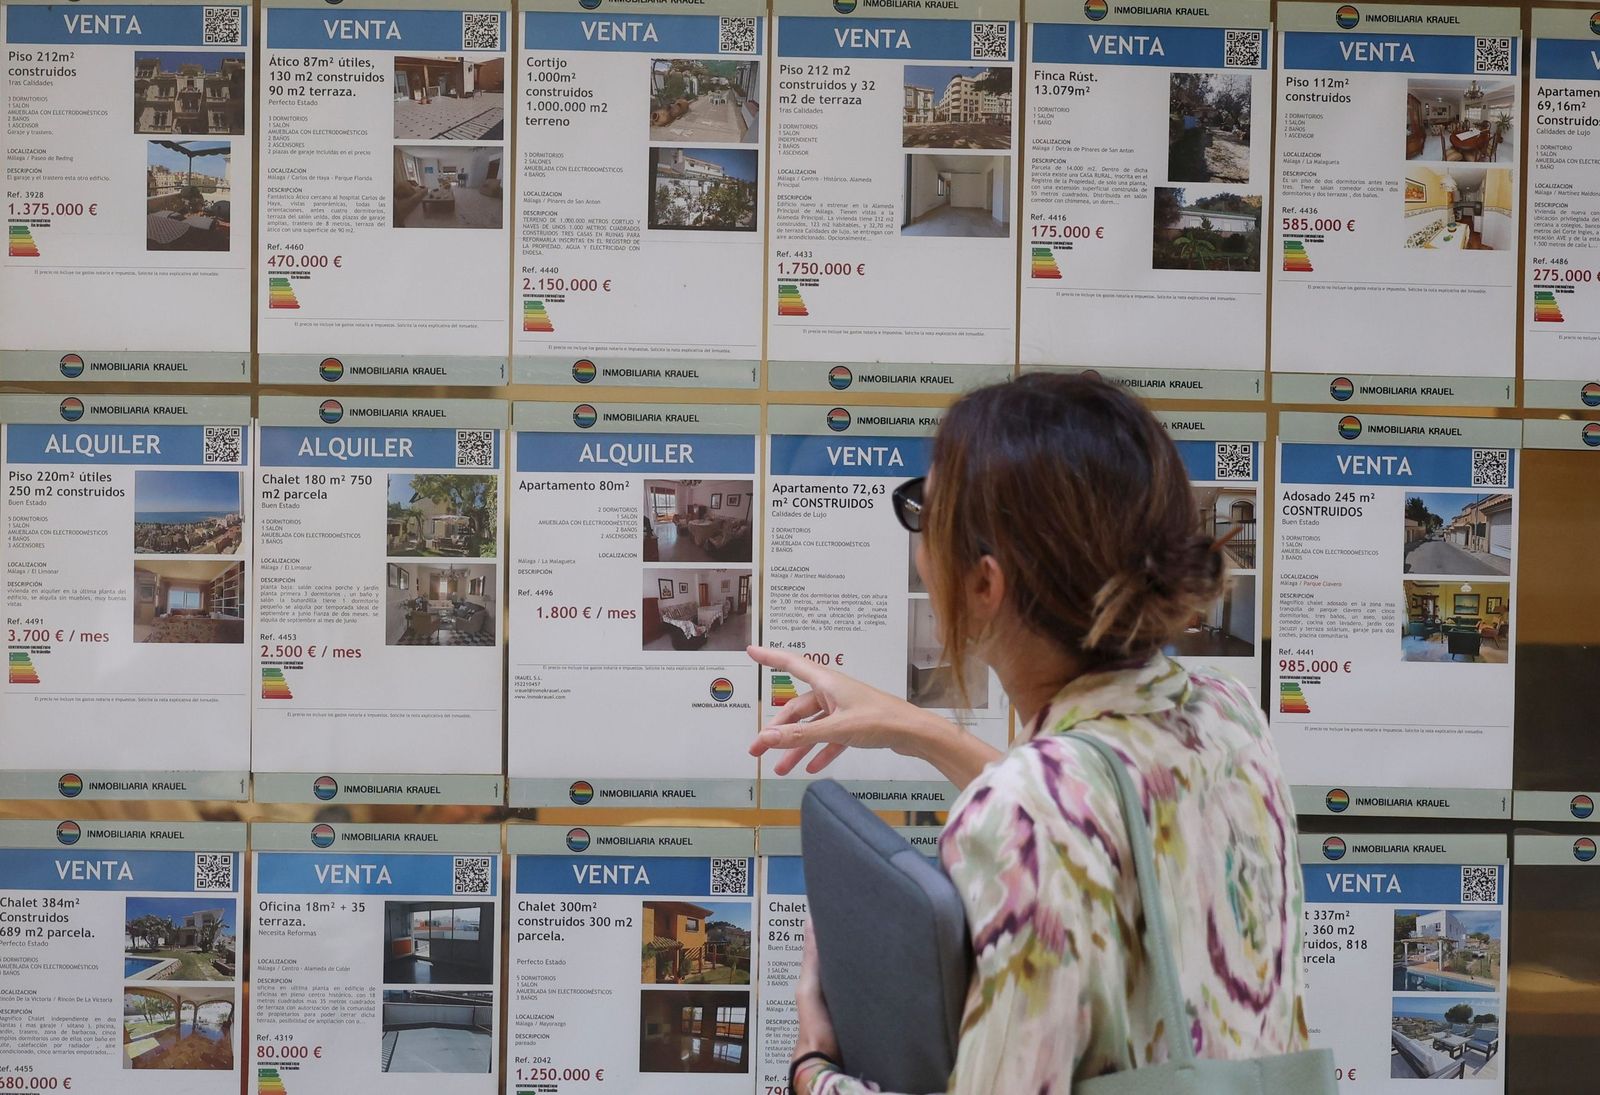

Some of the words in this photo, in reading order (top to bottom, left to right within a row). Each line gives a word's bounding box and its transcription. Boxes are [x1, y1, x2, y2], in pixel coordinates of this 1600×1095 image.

[1114, 6, 1172, 15] INMOBILIARIA
[64, 14, 142, 34] VENTA
[324, 20, 401, 40] VENTA
[581, 21, 658, 42] VENTA
[834, 28, 911, 48] VENTA
[1088, 35, 1164, 56] VENTA
[1340, 41, 1414, 62] VENTA
[9, 51, 32, 61] Piso
[37, 51, 74, 62] 212m²
[269, 54, 299, 66] Ático
[303, 56, 334, 67] 87m²
[338, 57, 375, 69] útiles,
[527, 57, 567, 70] Cortijo
[780, 64, 803, 75] Piso
[808, 65, 828, 75] 212
[833, 66, 850, 75] m2
[8, 66, 76, 76] construidos
[270, 71, 291, 81] 130
[295, 71, 313, 81] m2
[317, 72, 384, 82] construidos
[528, 72, 576, 82] 1.000m²
[1034, 70, 1065, 81] Finca
[1070, 71, 1098, 82] Rúst.
[780, 80, 846, 90] construidos
[850, 83, 857, 93] y
[862, 80, 875, 91] 32
[1286, 77, 1309, 87] Piso
[1314, 78, 1349, 88] 112m²
[269, 85, 283, 95] 90
[287, 86, 305, 96] m2
[309, 87, 356, 96] terraza.
[526, 88, 593, 98] construidos
[1035, 85, 1090, 96] 13.079m²
[780, 94, 797, 104] m2
[801, 94, 815, 104] de
[819, 96, 862, 105] terraza
[1286, 92, 1351, 103] construidos
[527, 101, 586, 112] 1.000.000
[590, 102, 608, 112] m2
[1538, 100, 1586, 112] 69,16m²
[526, 116, 570, 126] terreno
[9, 203, 83, 216] 1.375.000
[89, 204, 97, 216] €
[1283, 218, 1342, 231] 585.000
[1347, 219, 1355, 232] €
[1032, 225, 1090, 238] 175.000
[1096, 226, 1104, 239] €
[267, 255, 328, 268] 470.000
[333, 256, 342, 268] €
[778, 262, 851, 275] 1.750.000
[857, 264, 865, 276] €
[523, 278, 597, 291] 2.150.000
[603, 279, 611, 292] €
[603, 413, 662, 421] INMOBILIARIA
[666, 414, 699, 422] KRAUEL
[45, 434, 161, 457] ALQUILER
[298, 437, 414, 460] ALQUILER
[579, 443, 694, 466] ALQUILER
[826, 446, 904, 466] VENTA
[1337, 455, 1412, 476] VENTA
[9, 471, 32, 481] Piso
[37, 471, 74, 482] 220m²
[80, 472, 112, 482] útiles
[262, 474, 300, 484] Chalet
[305, 474, 326, 485] 180
[330, 475, 345, 484] m²
[351, 475, 372, 485] 750
[9, 486, 31, 496] 250
[35, 486, 52, 496] m2
[57, 487, 125, 497] construidos
[519, 480, 595, 492] Apartamento
[600, 480, 629, 491] 80m²
[772, 483, 848, 495] Apartamento
[853, 484, 885, 496] 72,63
[262, 489, 280, 499] m2
[284, 489, 327, 501] parcela
[1283, 491, 1330, 502] Adosado
[1335, 492, 1355, 502] 245
[1360, 493, 1374, 502] m²
[772, 497, 787, 507] m²
[792, 498, 874, 509] CONSTRUIDOS
[1282, 505, 1362, 517] COSNTRUIDOS
[537, 606, 577, 619] 1.800
[582, 606, 591, 619] €
[596, 607, 602, 619] /
[608, 610, 636, 619] mes
[8, 629, 50, 642] 3.700
[56, 630, 64, 642] €
[69, 630, 75, 642] /
[80, 633, 109, 642] mes
[261, 645, 302, 658] 2.500
[307, 645, 316, 658] €
[321, 646, 327, 658] /
[333, 649, 362, 658] mes
[1279, 660, 1338, 673] 985.000
[1343, 661, 1351, 673] €
[55, 860, 133, 880] VENTA
[314, 864, 392, 884] VENTA
[573, 865, 650, 884] VENTA
[1326, 873, 1401, 893] VENTA
[0, 897, 38, 907] Chalet
[42, 898, 80, 908] 384m²
[259, 901, 301, 912] Oficina
[306, 902, 335, 912] 18m²
[352, 902, 365, 912] 35
[518, 901, 556, 911] Chalet
[560, 902, 596, 912] 300m²
[769, 902, 806, 912] Chalet
[0, 912, 69, 922] Construidos
[259, 917, 305, 926] terraza.
[518, 917, 585, 926] construidos
[590, 917, 610, 927] 300
[615, 917, 632, 927] m2
[0, 927, 21, 937] 689
[25, 927, 43, 937] m2
[48, 928, 94, 940] parcela.
[518, 931, 564, 943] parcela.
[257, 1046, 308, 1058] 80.000
[313, 1046, 322, 1058] €
[516, 1068, 590, 1081] 1.250.000
[596, 1069, 604, 1081] €
